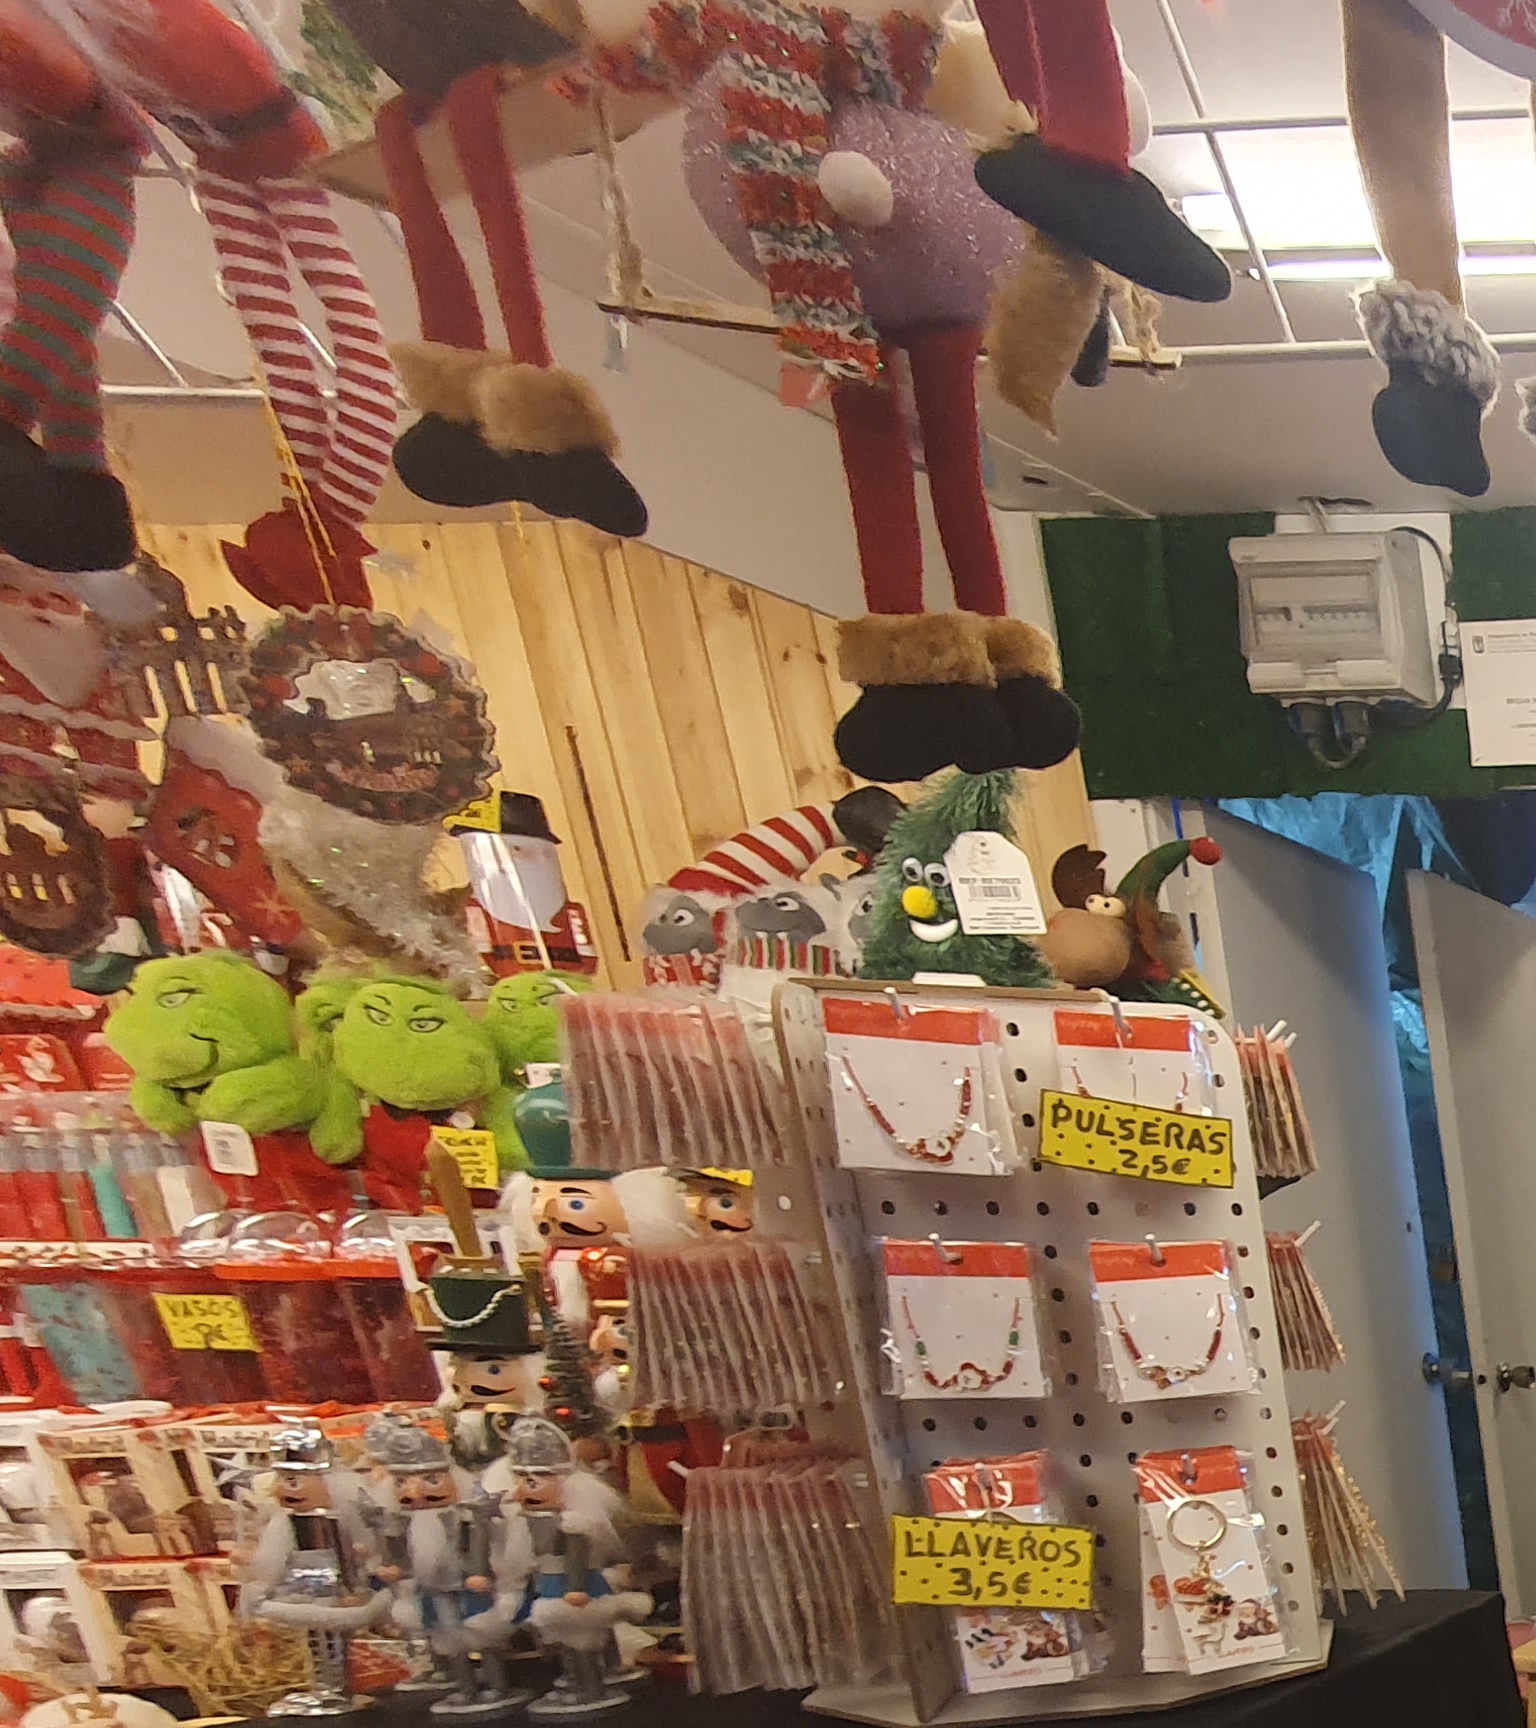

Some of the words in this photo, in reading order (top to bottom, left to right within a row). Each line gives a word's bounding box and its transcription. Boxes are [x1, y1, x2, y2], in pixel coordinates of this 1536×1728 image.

[1051, 1103, 1228, 1156] PULSERAS
[1118, 1149, 1192, 1178] 2,5€
[905, 1530, 1081, 1568] LLAVEROS
[949, 1567, 1033, 1601] 3,5€
